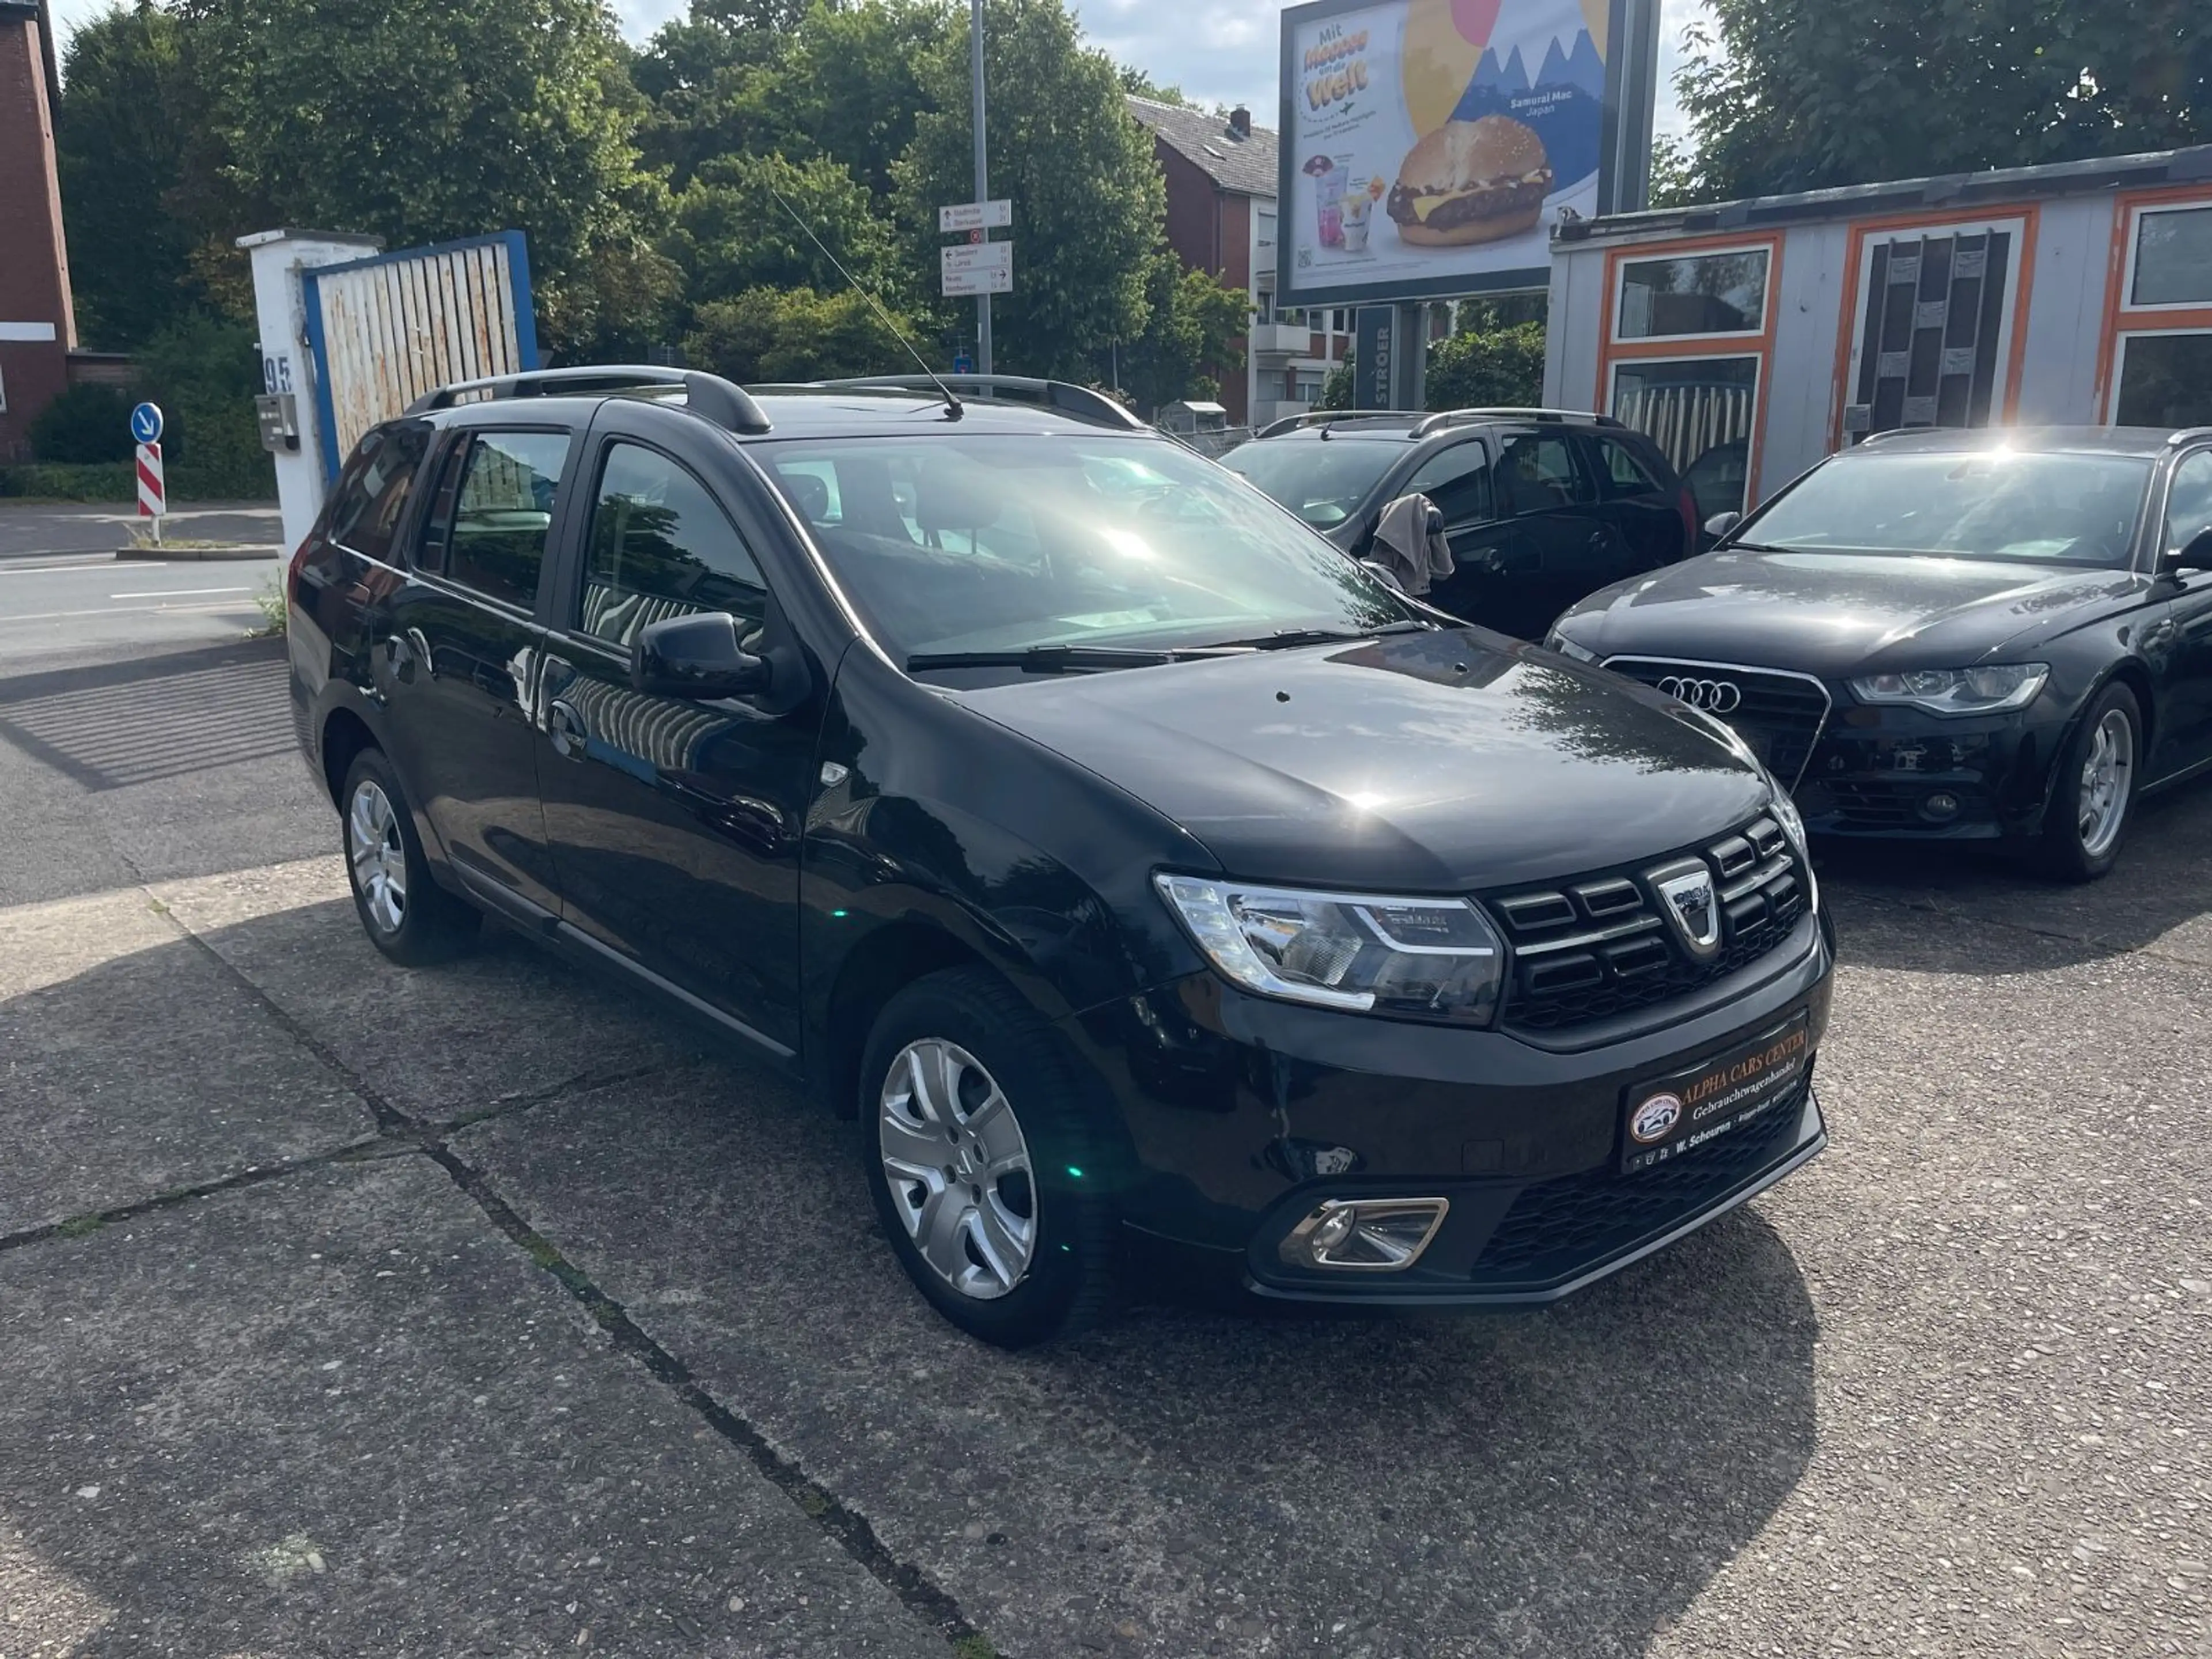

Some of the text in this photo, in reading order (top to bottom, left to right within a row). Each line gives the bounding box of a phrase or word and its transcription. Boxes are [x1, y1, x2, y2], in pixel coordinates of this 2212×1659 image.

[1319, 23, 1342, 45] Mit
[1306, 59, 1369, 111] Welt
[1510, 90, 1572, 109] Samurai Mac
[1526, 104, 1555, 118] Japan
[1682, 1029, 1804, 1105] ALPHA CARS CENTER
[1693, 1057, 1796, 1120] Gebrauchtwagenhandel
